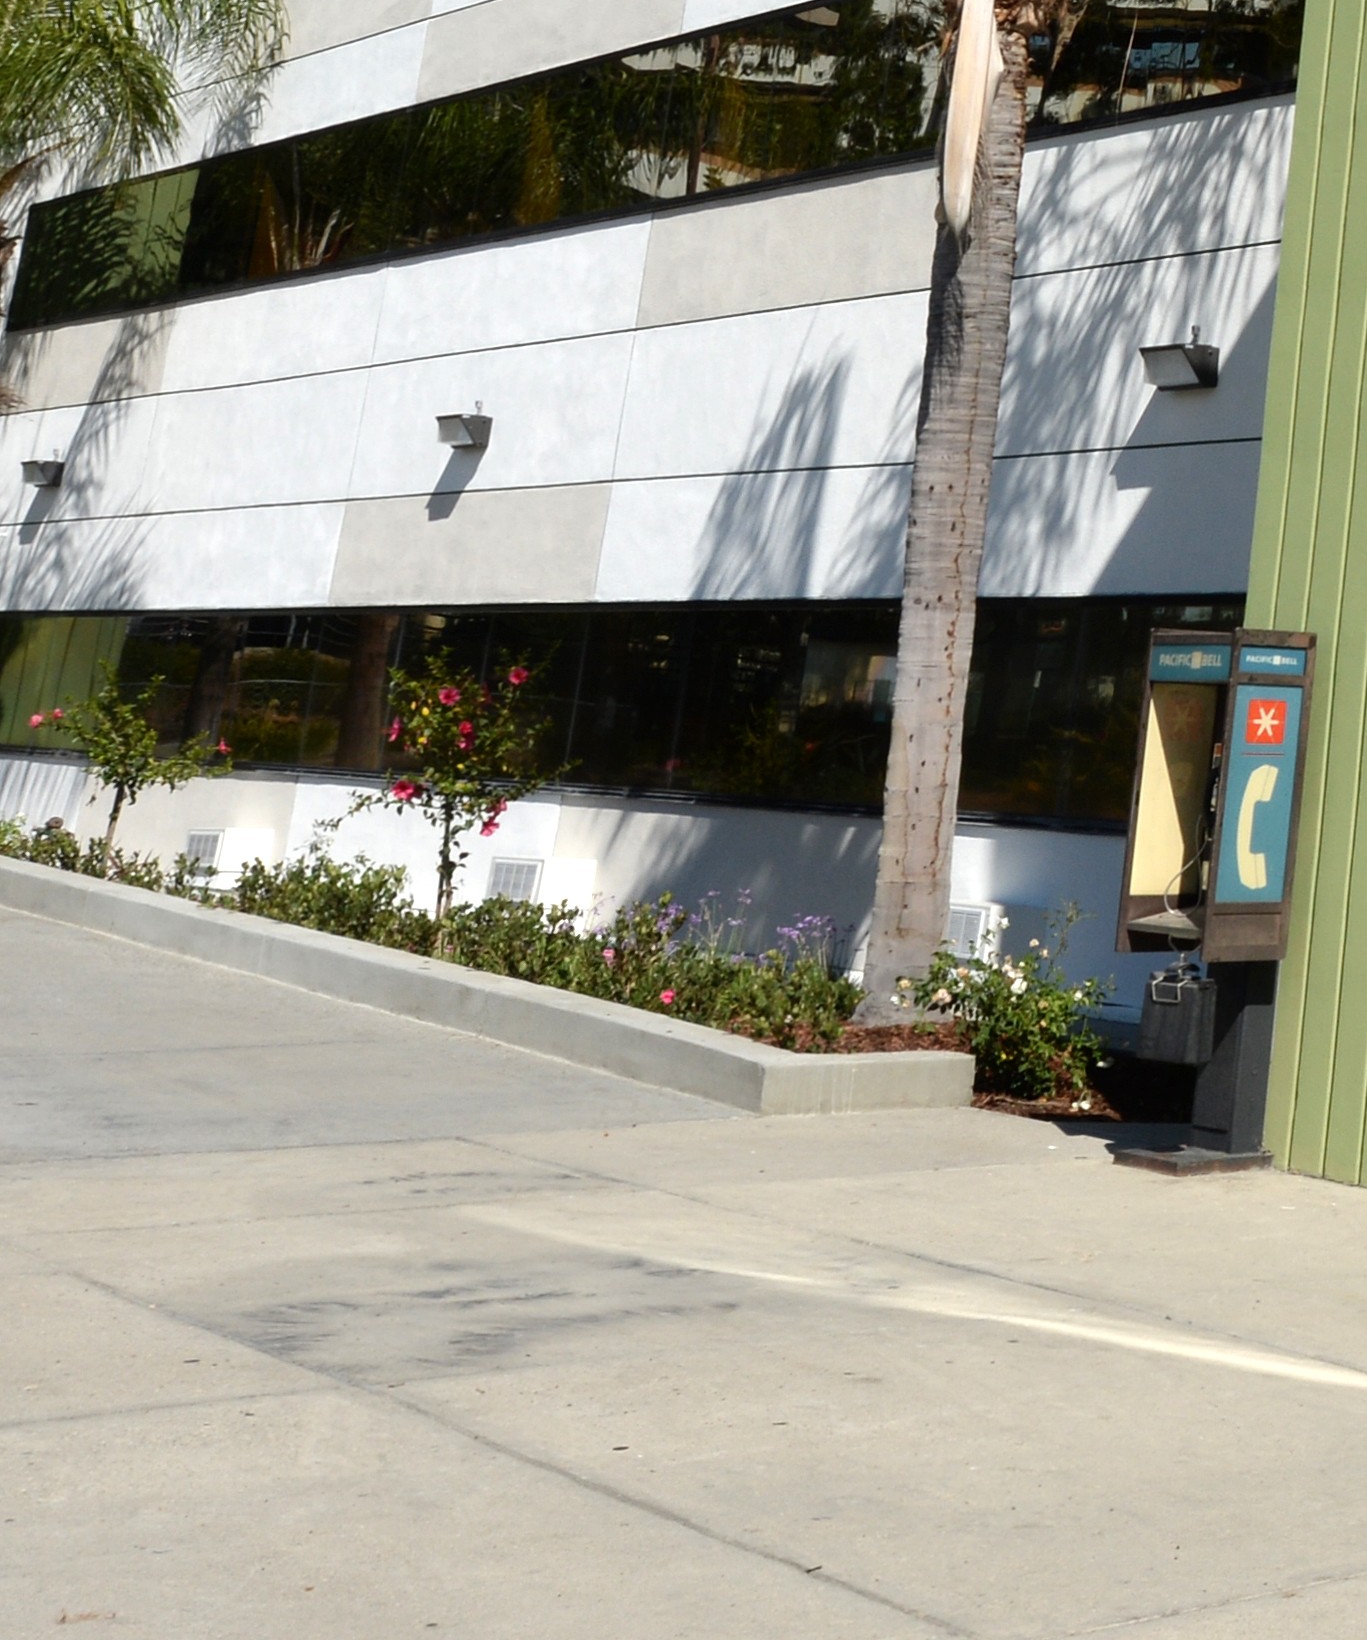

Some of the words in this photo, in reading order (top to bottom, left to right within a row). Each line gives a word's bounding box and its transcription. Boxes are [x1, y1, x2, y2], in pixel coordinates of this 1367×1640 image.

[1159, 653, 1192, 667] PACIFIC
[1202, 653, 1222, 667] BELL
[1245, 654, 1274, 664] PACIFIC
[1281, 656, 1298, 666] BELL
